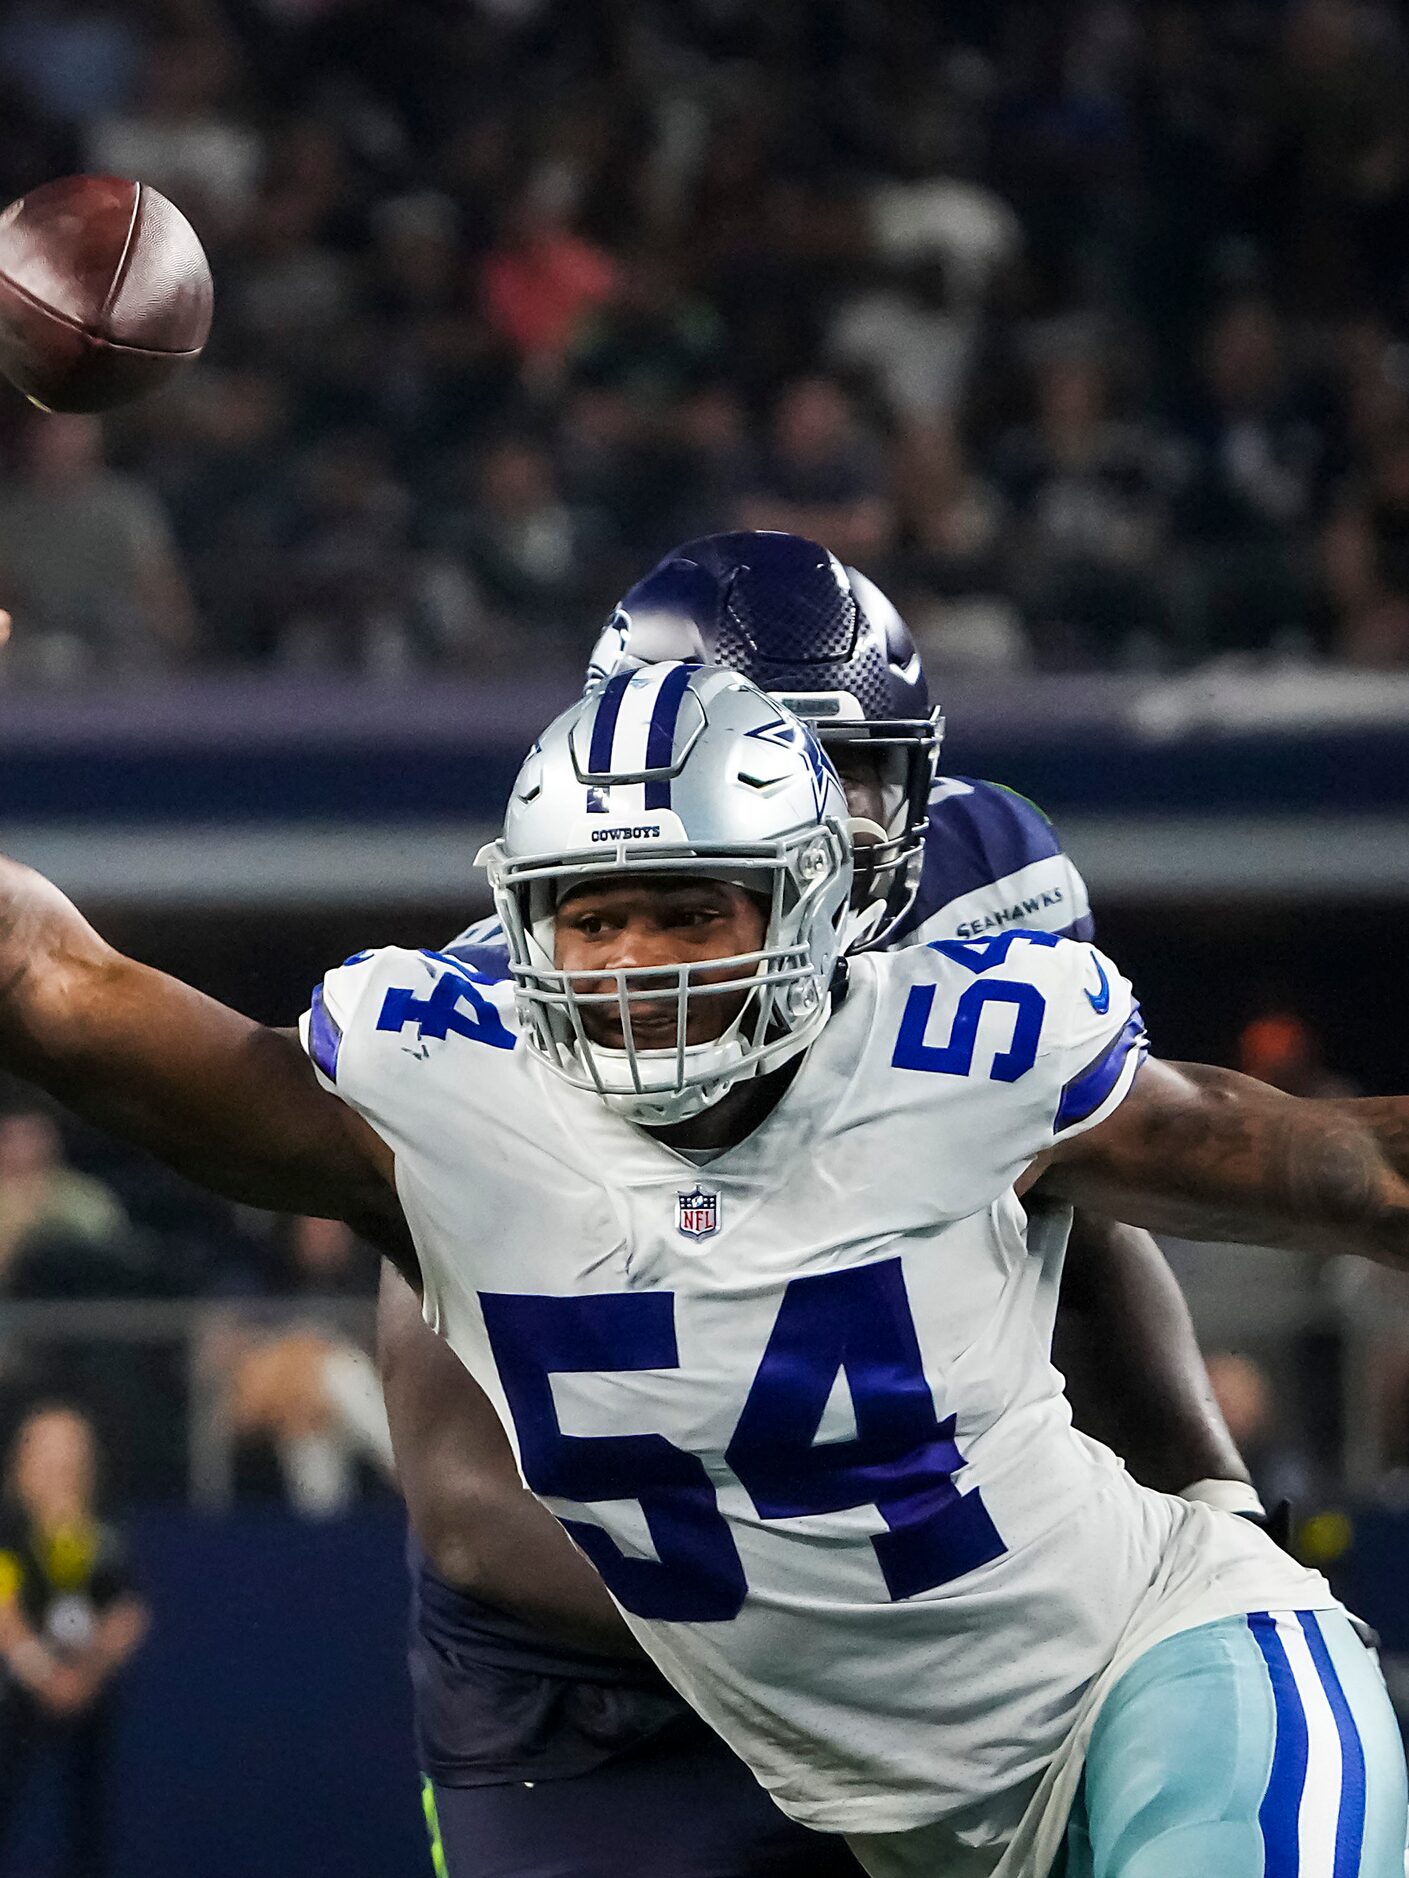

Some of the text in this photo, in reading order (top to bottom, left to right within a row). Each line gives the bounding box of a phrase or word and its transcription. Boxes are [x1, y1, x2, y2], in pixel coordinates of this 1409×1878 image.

[591, 825, 661, 842] COWBOYS
[956, 887, 1063, 939] SEAHAWKS
[683, 1210, 713, 1231] NFL
[477, 1257, 1008, 1622] 54
